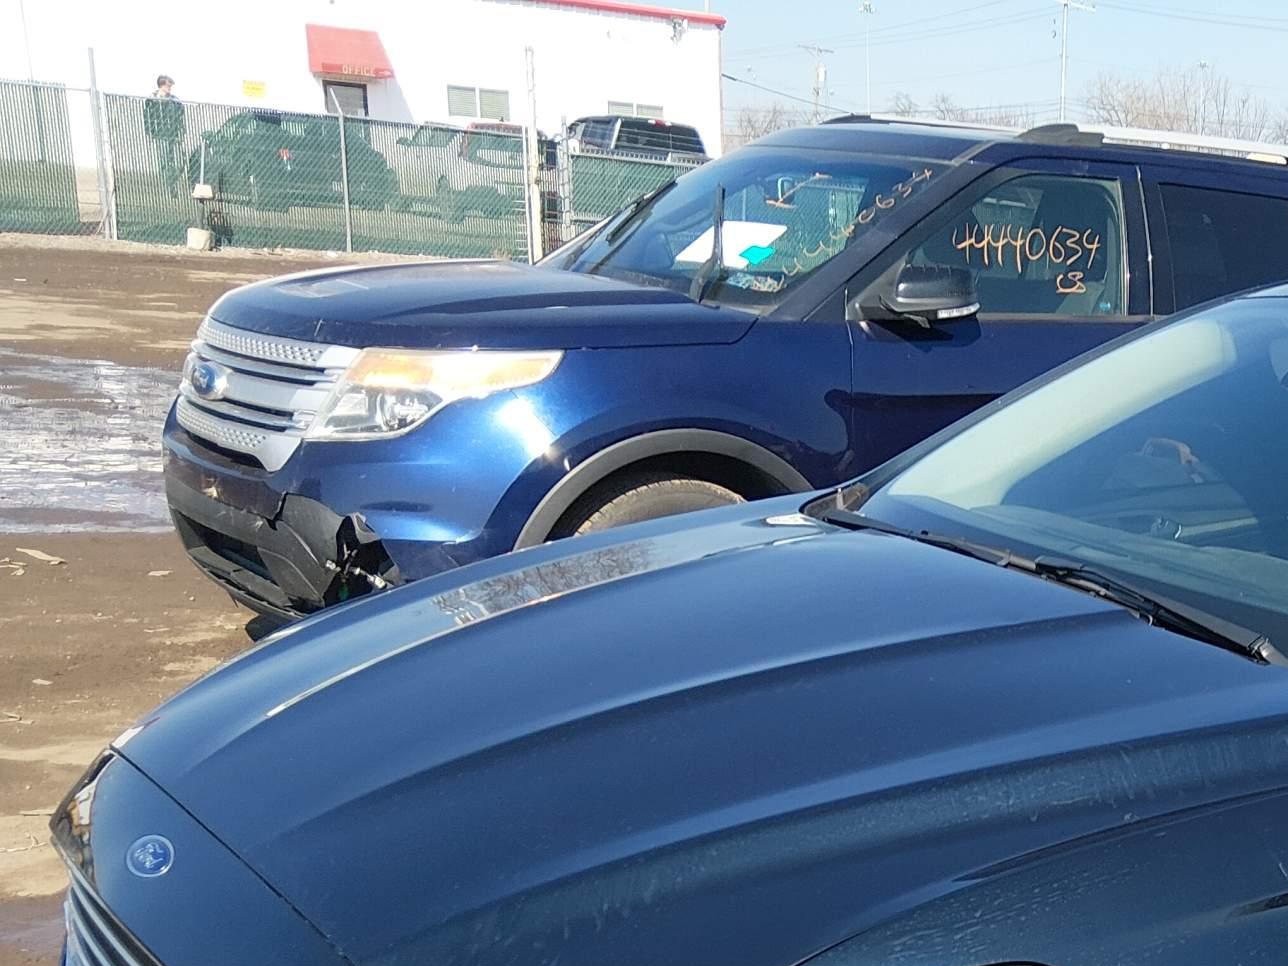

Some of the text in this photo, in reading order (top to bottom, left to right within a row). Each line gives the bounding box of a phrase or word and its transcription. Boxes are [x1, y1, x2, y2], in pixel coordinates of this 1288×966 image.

[342, 64, 376, 77] OFFICE
[952, 222, 1100, 274] 44440634
[134, 842, 165, 870] Ford
